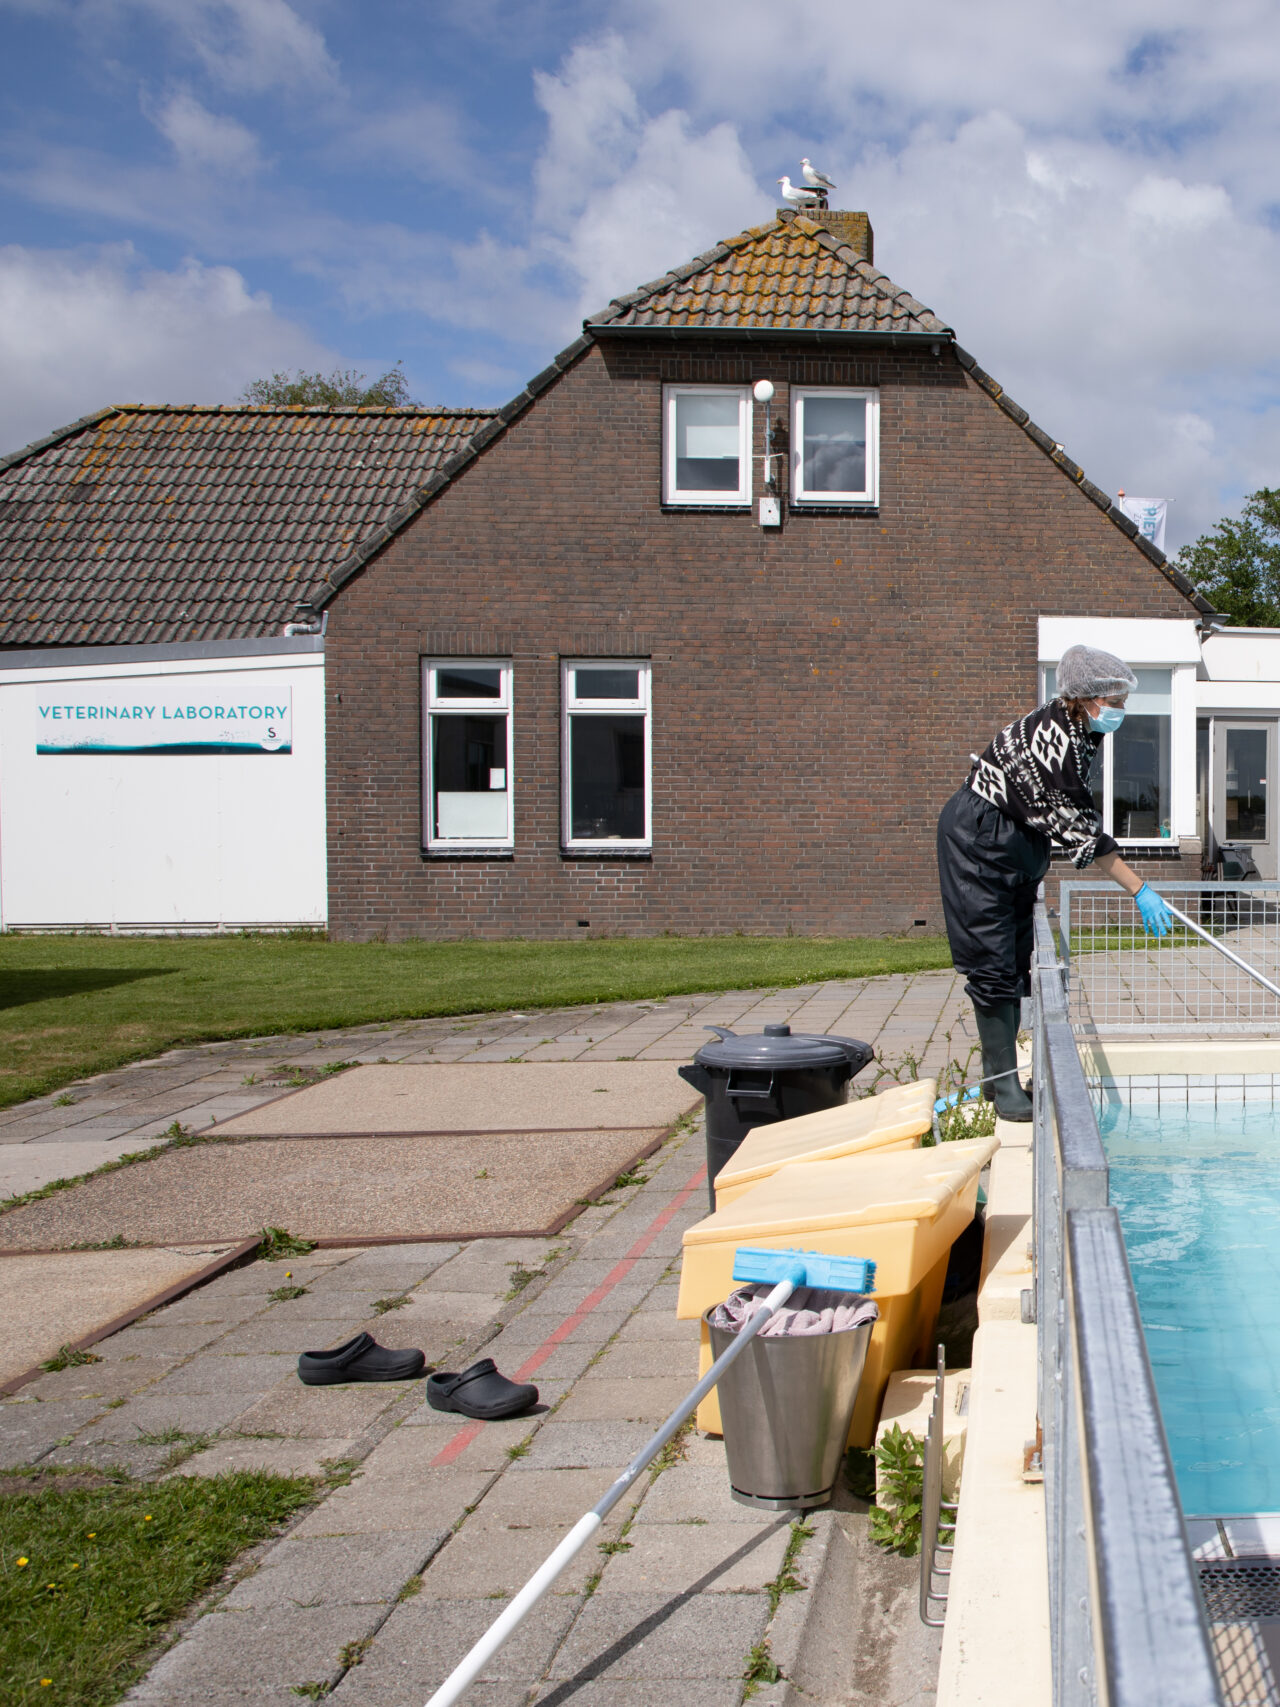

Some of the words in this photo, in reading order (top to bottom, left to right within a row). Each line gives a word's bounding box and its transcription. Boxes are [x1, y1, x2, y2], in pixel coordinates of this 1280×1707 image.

[1143, 507, 1157, 543] PIET
[39, 705, 155, 720] VETERINARY
[162, 705, 288, 719] LABORATORY
[267, 727, 277, 739] S
